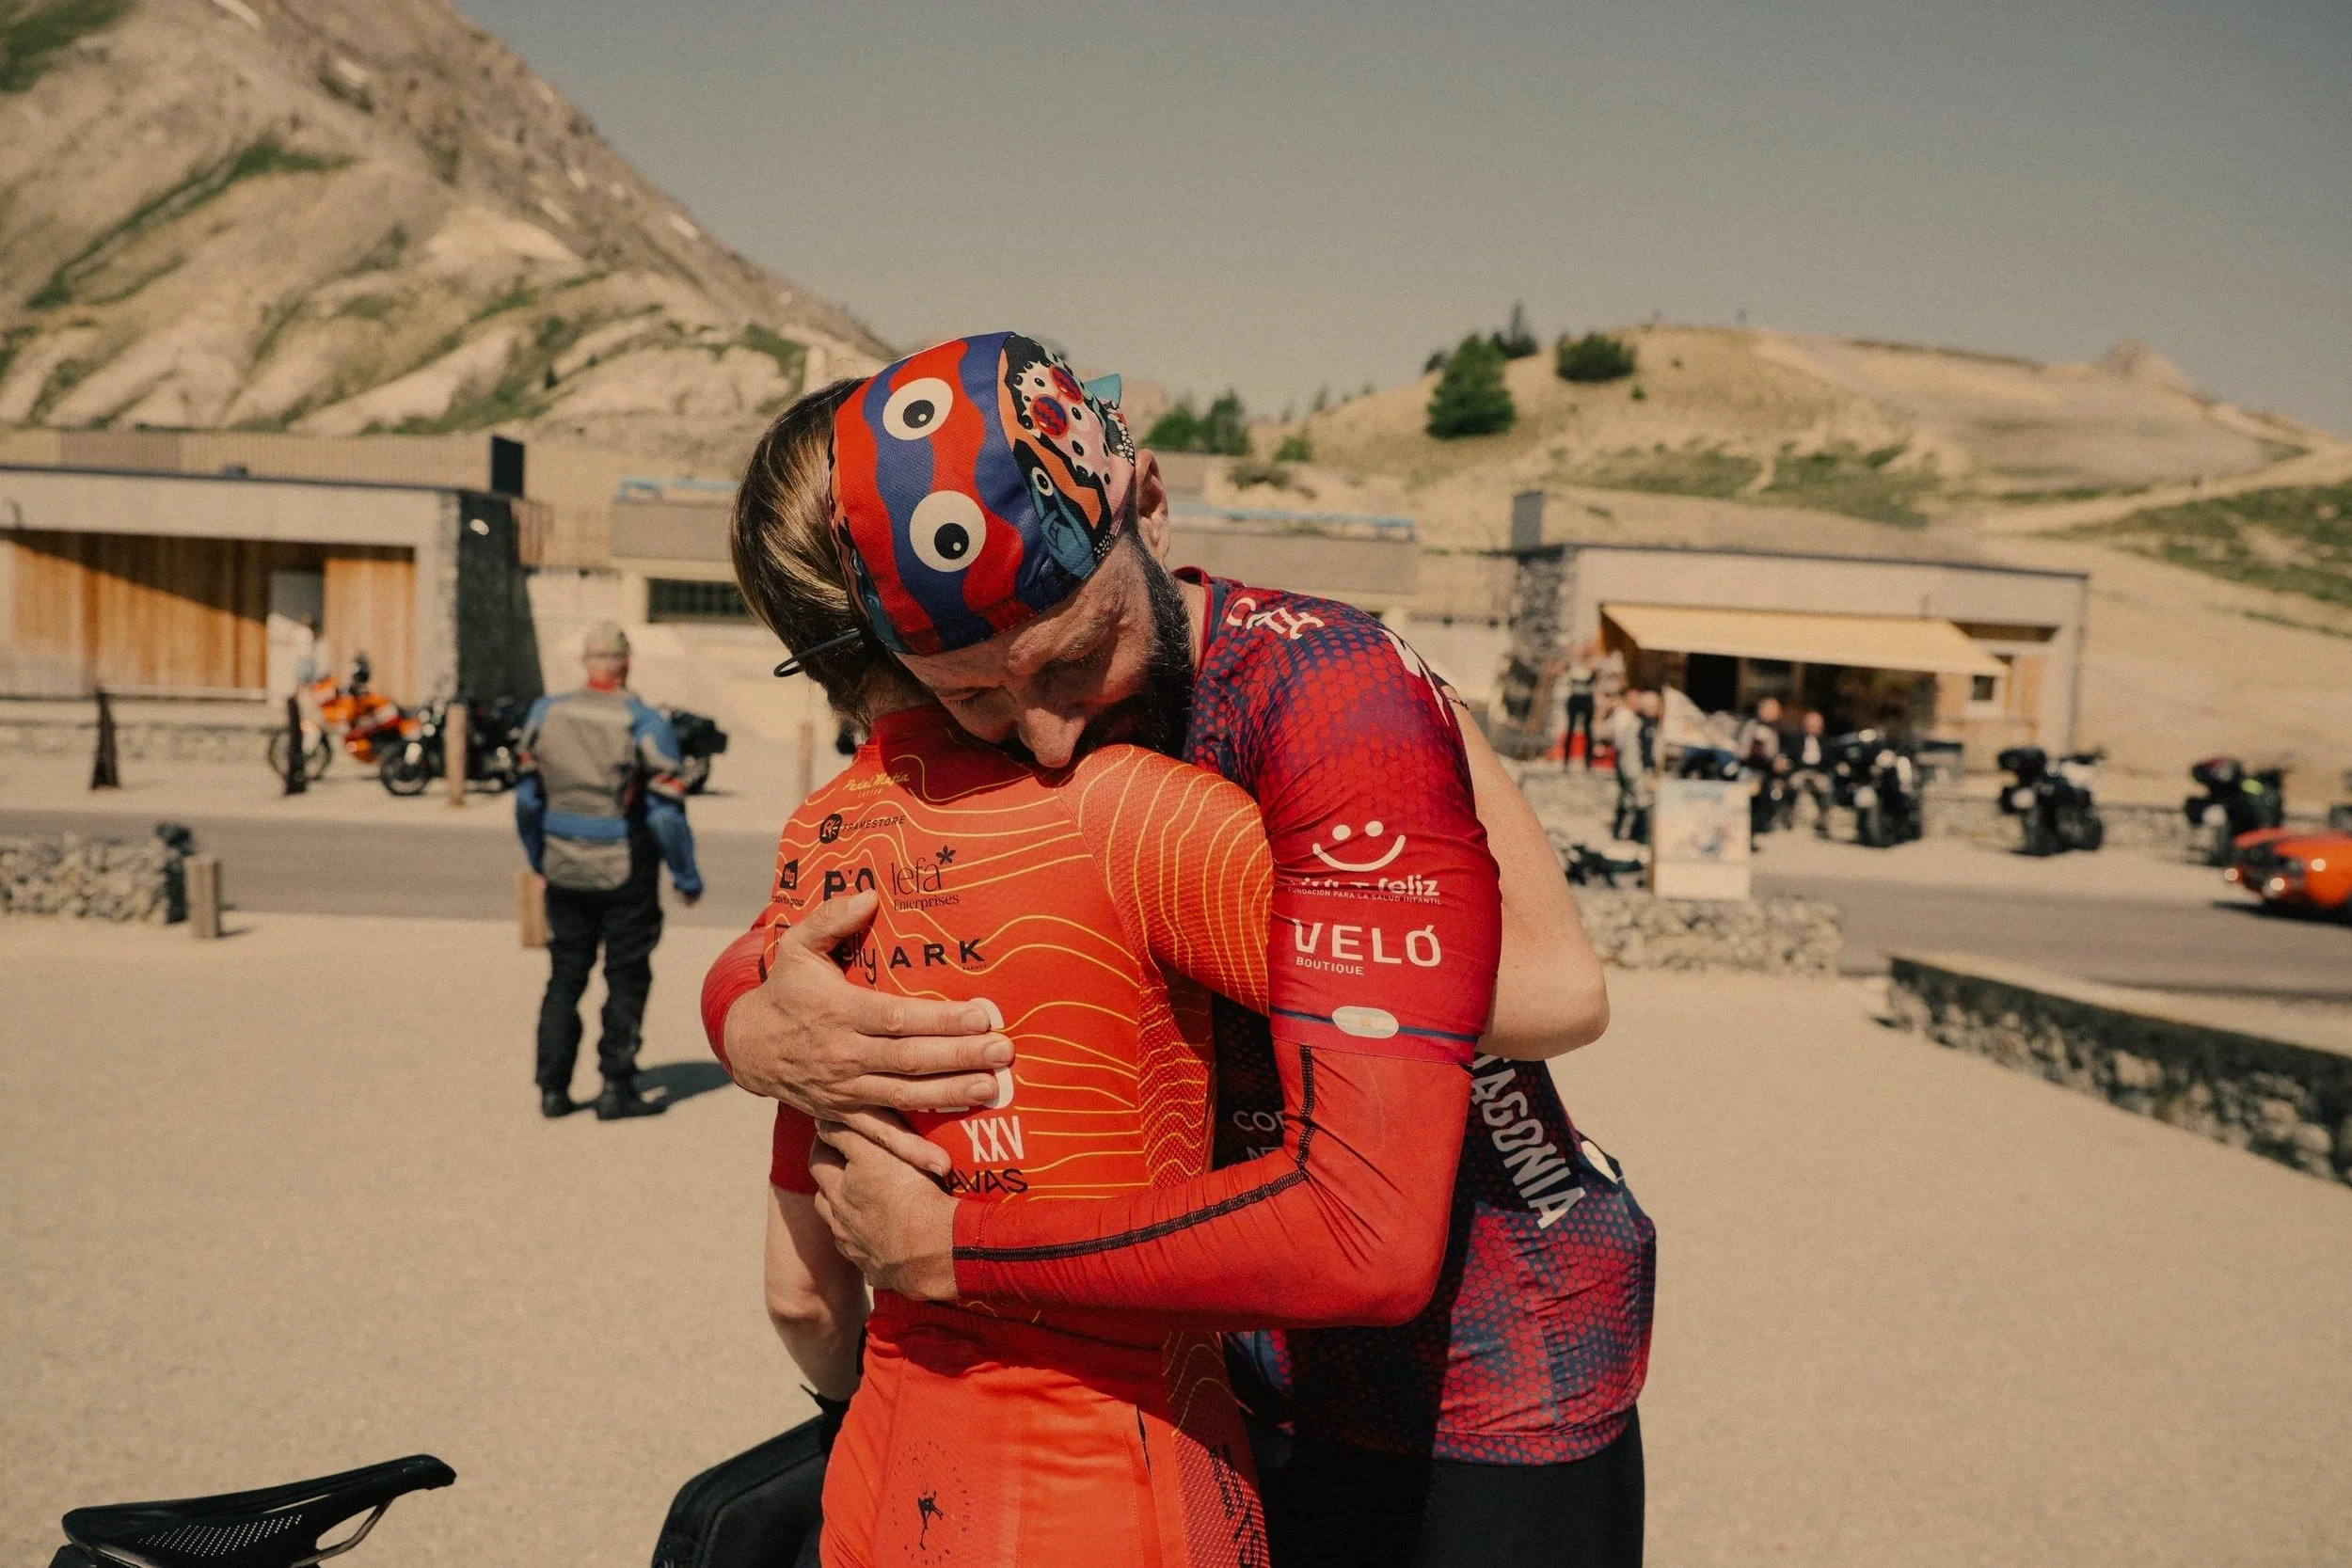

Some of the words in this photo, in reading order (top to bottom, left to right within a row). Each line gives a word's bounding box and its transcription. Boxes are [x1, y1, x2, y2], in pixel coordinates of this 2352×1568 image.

[872, 771, 911, 787] Mafia
[842, 816, 906, 832] FRAMESTORE
[890, 857, 943, 895] lefa
[894, 894, 960, 911] Enterprises
[1333, 891, 1355, 899] PARA
[1371, 894, 1401, 902] SALUD
[1403, 895, 1442, 906] INFANTIL
[889, 939, 986, 969] ARK
[1295, 957, 1364, 976] BOUTIQUE
[960, 1116, 1025, 1164] XXV
[948, 1168, 1028, 1195] AVAS
